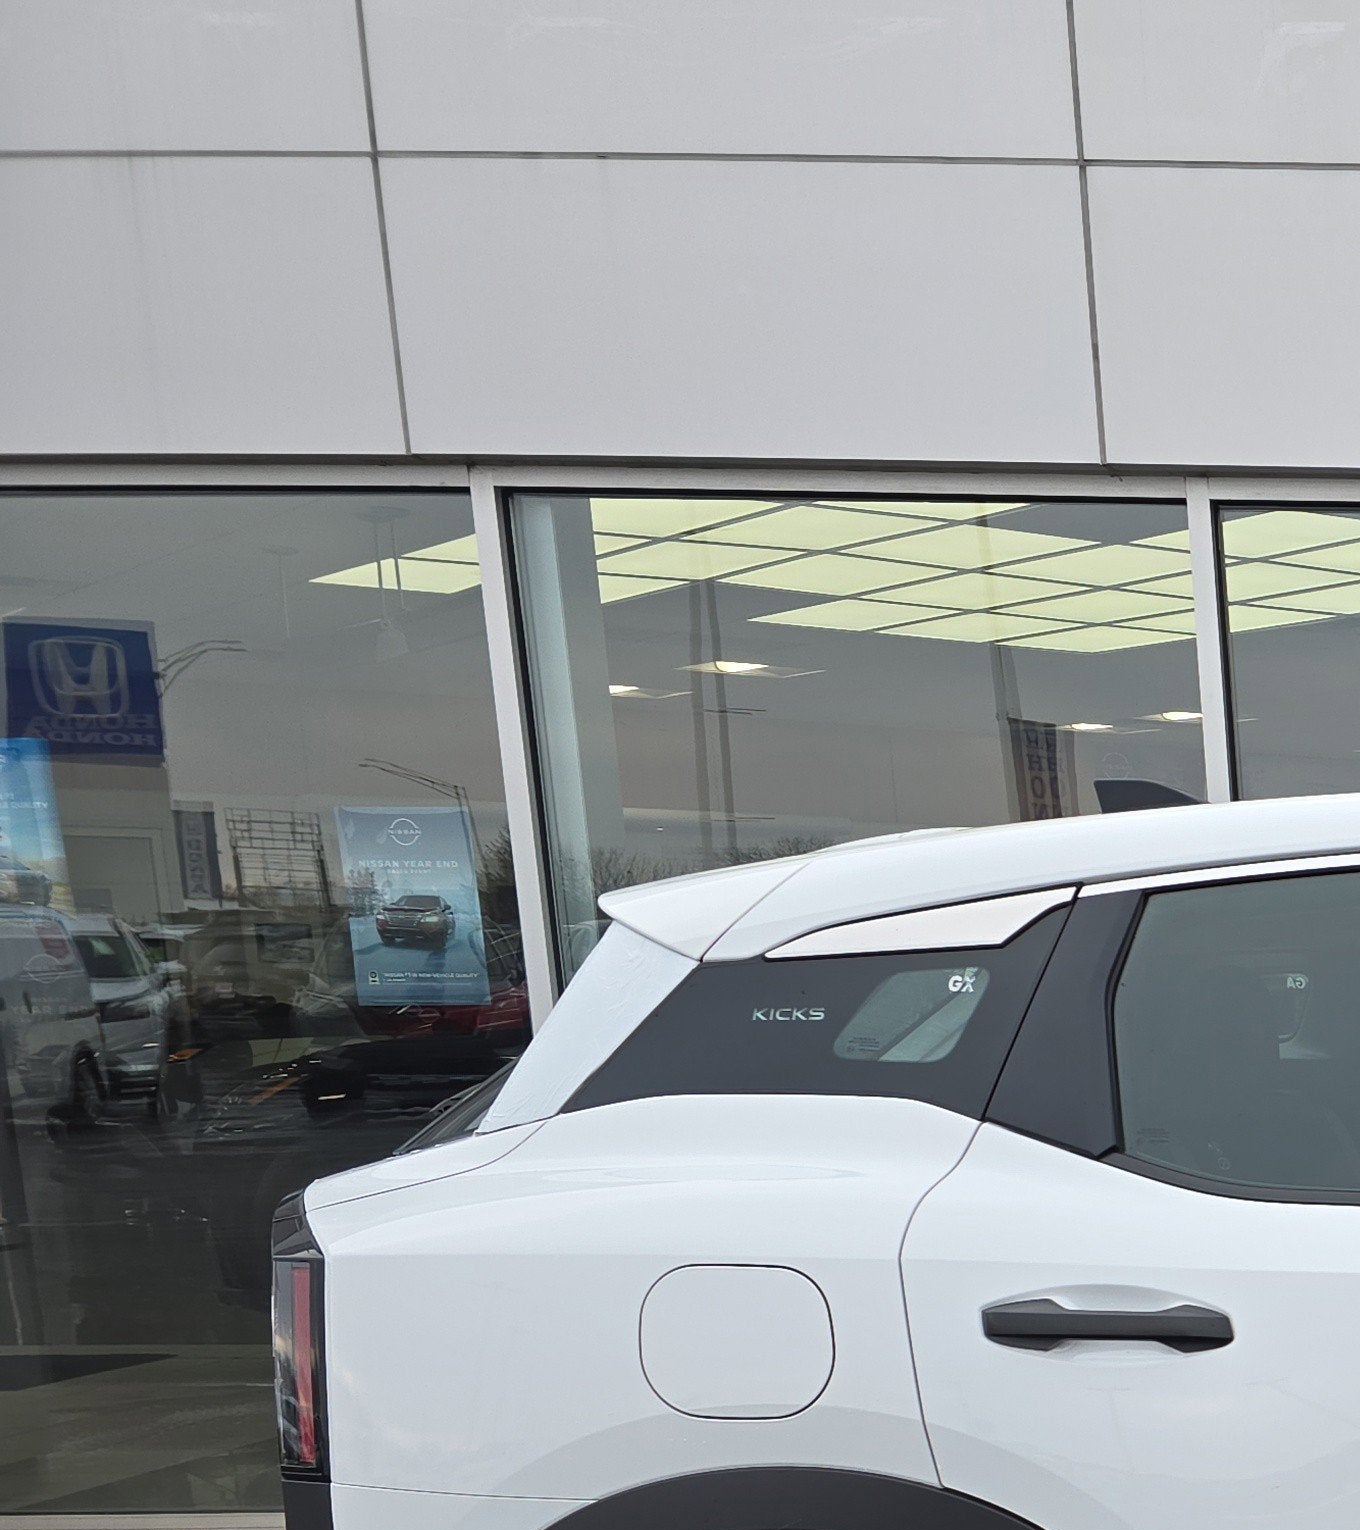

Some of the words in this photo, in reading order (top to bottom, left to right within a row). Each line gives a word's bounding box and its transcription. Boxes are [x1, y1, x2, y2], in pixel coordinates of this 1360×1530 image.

[358, 860, 400, 869] NISSAN
[402, 860, 432, 869] YEAR
[436, 859, 459, 869] END
[752, 1007, 825, 1021] KICKS
